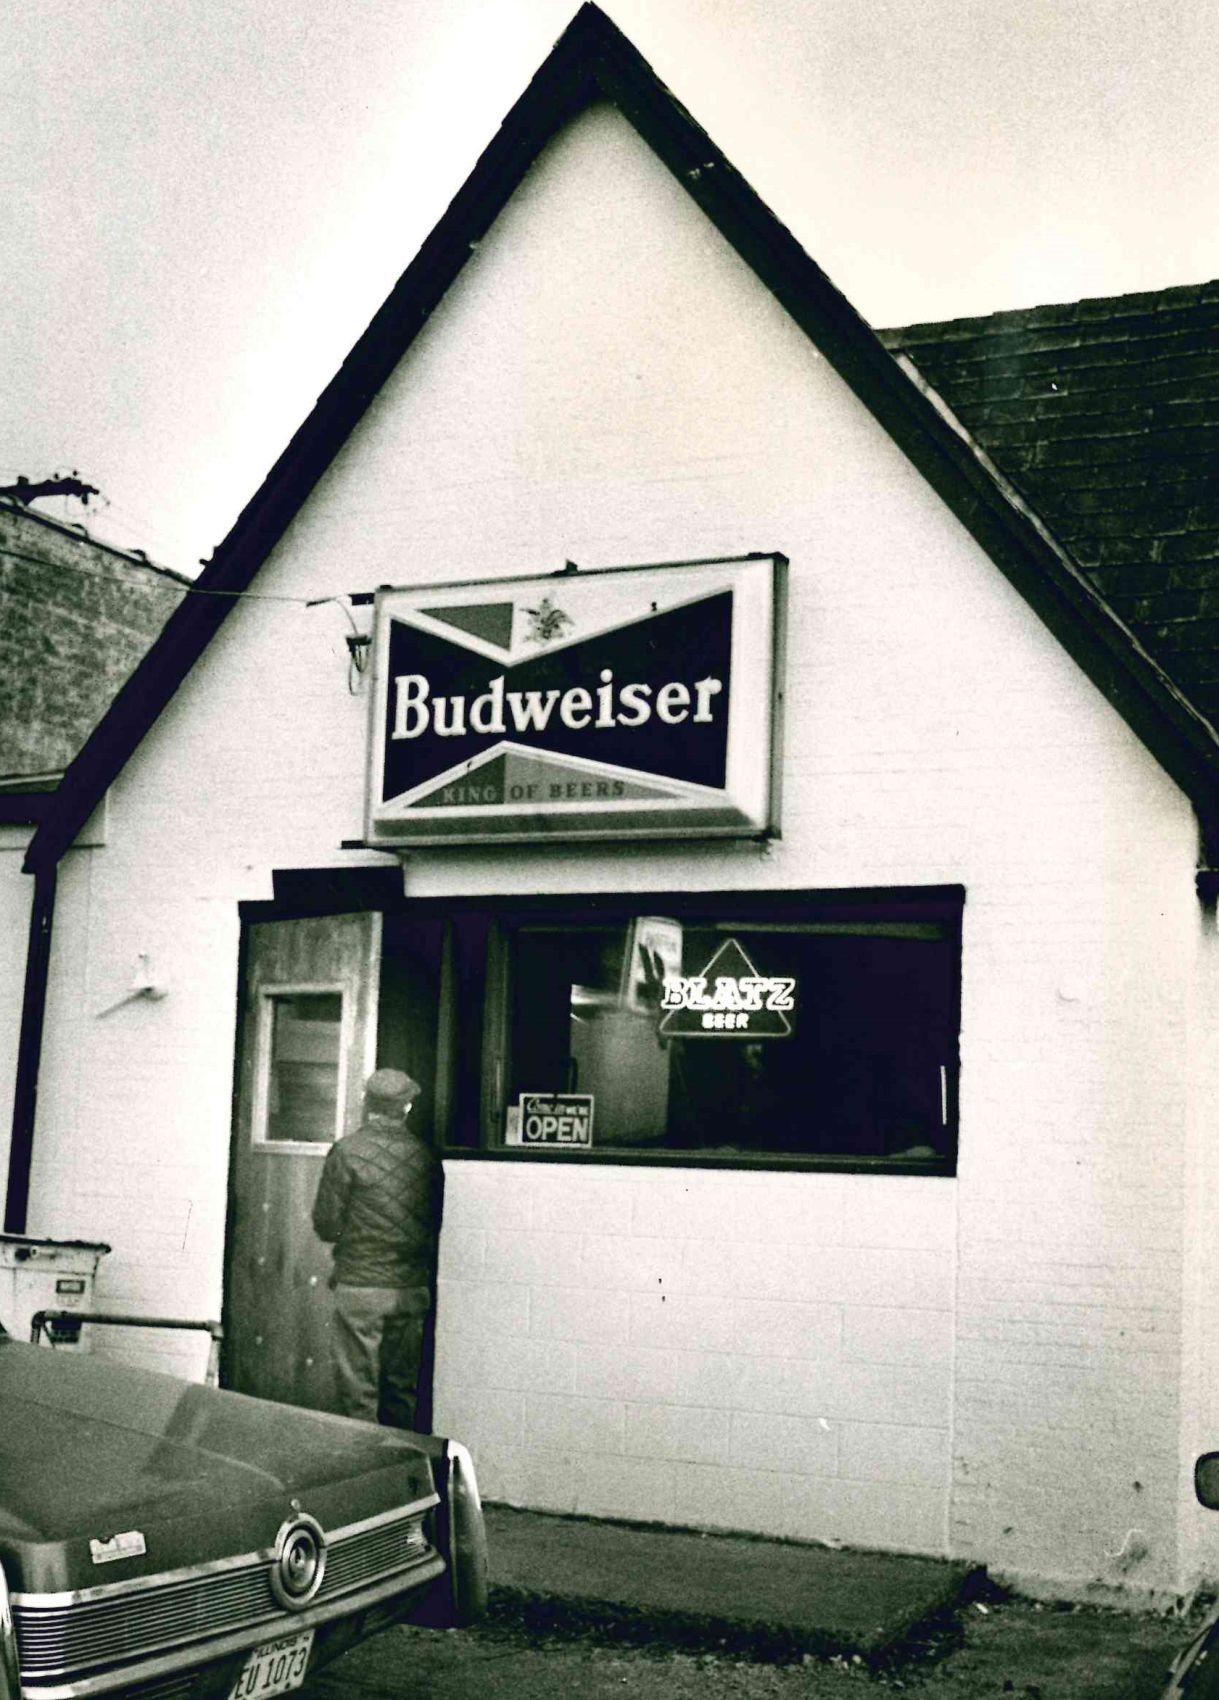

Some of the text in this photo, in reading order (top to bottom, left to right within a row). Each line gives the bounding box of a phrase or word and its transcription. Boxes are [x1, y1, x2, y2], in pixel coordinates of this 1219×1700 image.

[392, 669, 722, 740] Budweiser
[443, 781, 625, 803] KING OF BEERS
[661, 977, 796, 1010] BLATZ
[702, 1013, 749, 1029] BEER
[526, 1116, 589, 1142] OPEN
[262, 1647, 307, 1690] 1073
